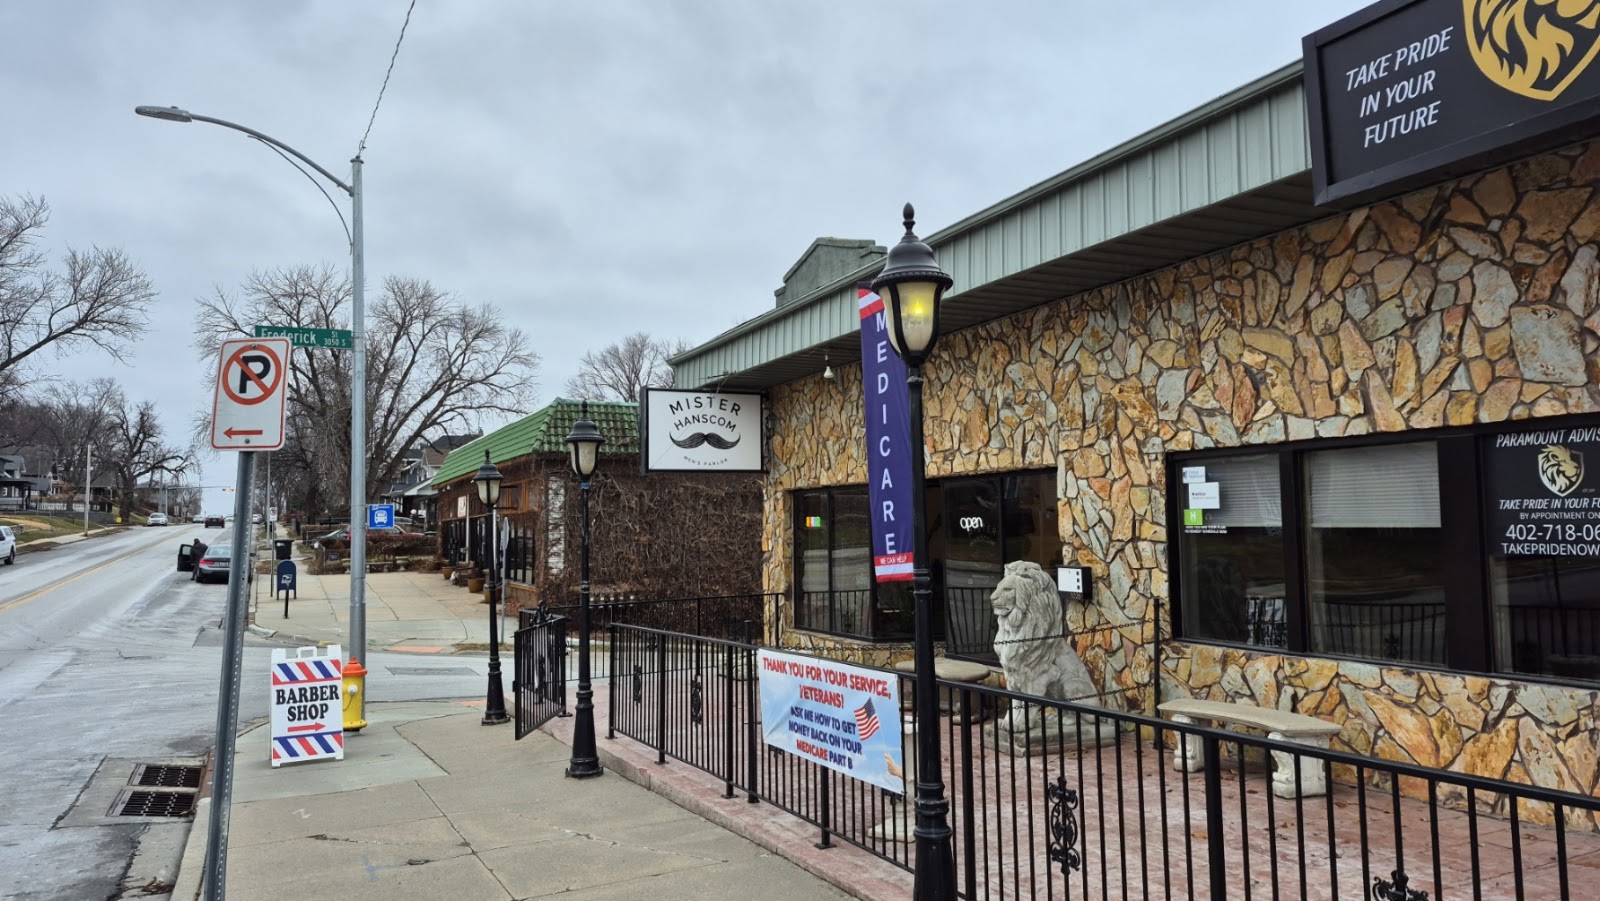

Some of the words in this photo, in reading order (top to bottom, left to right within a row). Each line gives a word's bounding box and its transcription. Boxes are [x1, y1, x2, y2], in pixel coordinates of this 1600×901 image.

[1345, 53, 1392, 91] TAKE
[1394, 26, 1453, 71] PRIDE
[1360, 91, 1380, 118] IN
[1386, 70, 1436, 108] YOUR
[1364, 101, 1441, 148] FUTURE
[324, 338, 340, 346] 3050
[342, 339, 346, 347] S
[332, 330, 338, 338] St
[669, 396, 741, 416] MISTER
[674, 414, 736, 432] HANSCOM
[876, 310, 896, 554] MEDICARE
[1496, 430, 1567, 447] PARAMOUNT
[1499, 500, 1521, 510] TAKE
[1522, 499, 1550, 509] PRIDE
[1550, 498, 1562, 508] IN
[1564, 498, 1589, 508] YOUR
[960, 517, 984, 532] open
[1520, 512, 1528, 520] BY
[1530, 512, 1585, 520] APPOINTMENT
[1501, 543, 1600, 556] TAKEPRIDENOW
[763, 657, 788, 674] THANK
[788, 661, 804, 678] YOU
[806, 666, 822, 681] FOR
[823, 668, 848, 688] YOUR
[850, 674, 892, 699] SERVICE,
[276, 684, 340, 705] BARBER
[799, 684, 844, 708] VETERANS!
[287, 703, 329, 722] SHOP
[790, 706, 802, 719] ASK
[804, 709, 814, 721] ME
[814, 712, 831, 728] HOW
[832, 716, 840, 731] TO
[842, 720, 856, 736] GET
[788, 720, 810, 736] MONEY
[811, 726, 828, 742] BACK
[829, 732, 840, 746] ON
[842, 738, 862, 755] YOUR
[796, 738, 828, 761] MEDICARE
[829, 750, 846, 767] PART
[848, 757, 853, 770] B
